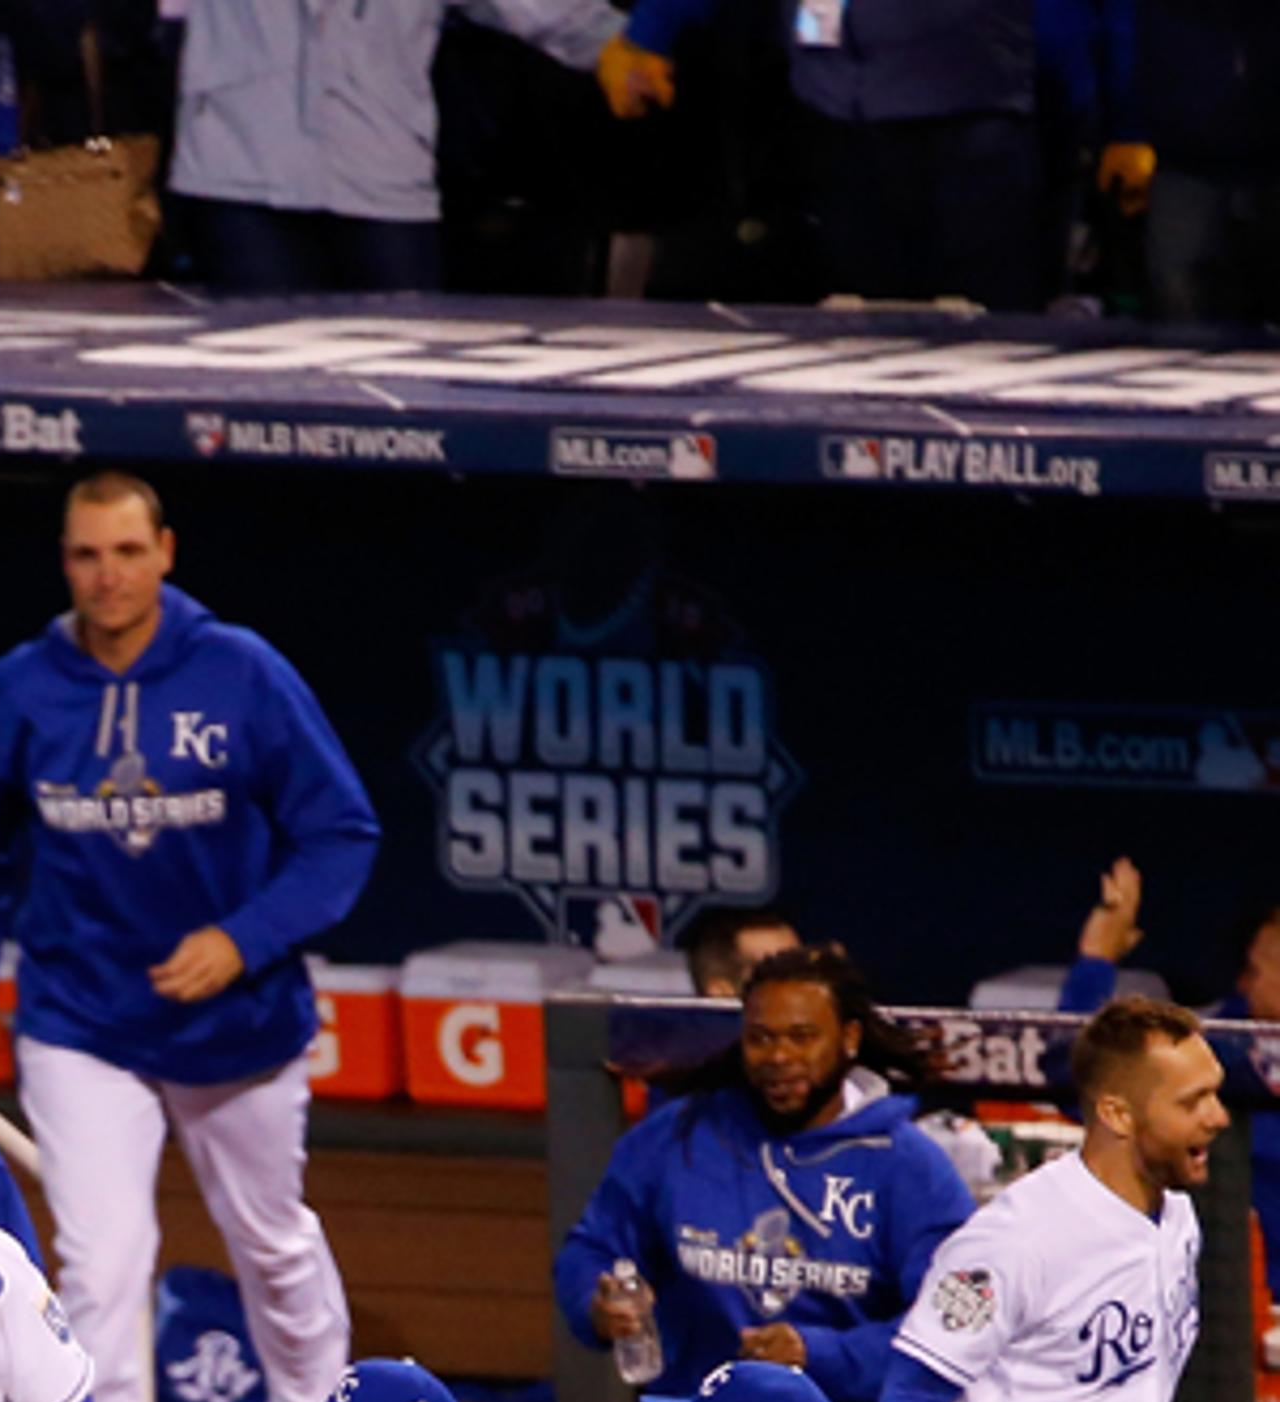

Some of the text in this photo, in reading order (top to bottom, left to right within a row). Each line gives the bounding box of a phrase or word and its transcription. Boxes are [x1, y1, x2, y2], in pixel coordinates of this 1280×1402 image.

[1, 404, 84, 455] Bat
[228, 422, 291, 455] MLB
[298, 425, 446, 462] NETWORK
[556, 438, 669, 469] MLB.com
[442, 649, 768, 773] WORLD
[170, 711, 228, 767] KC
[985, 719, 1190, 770] MLB.com
[444, 766, 774, 892] SERIES
[438, 1005, 506, 1086] G
[819, 1173, 874, 1239] KC
[677, 1242, 872, 1296] WORLD SERIES
